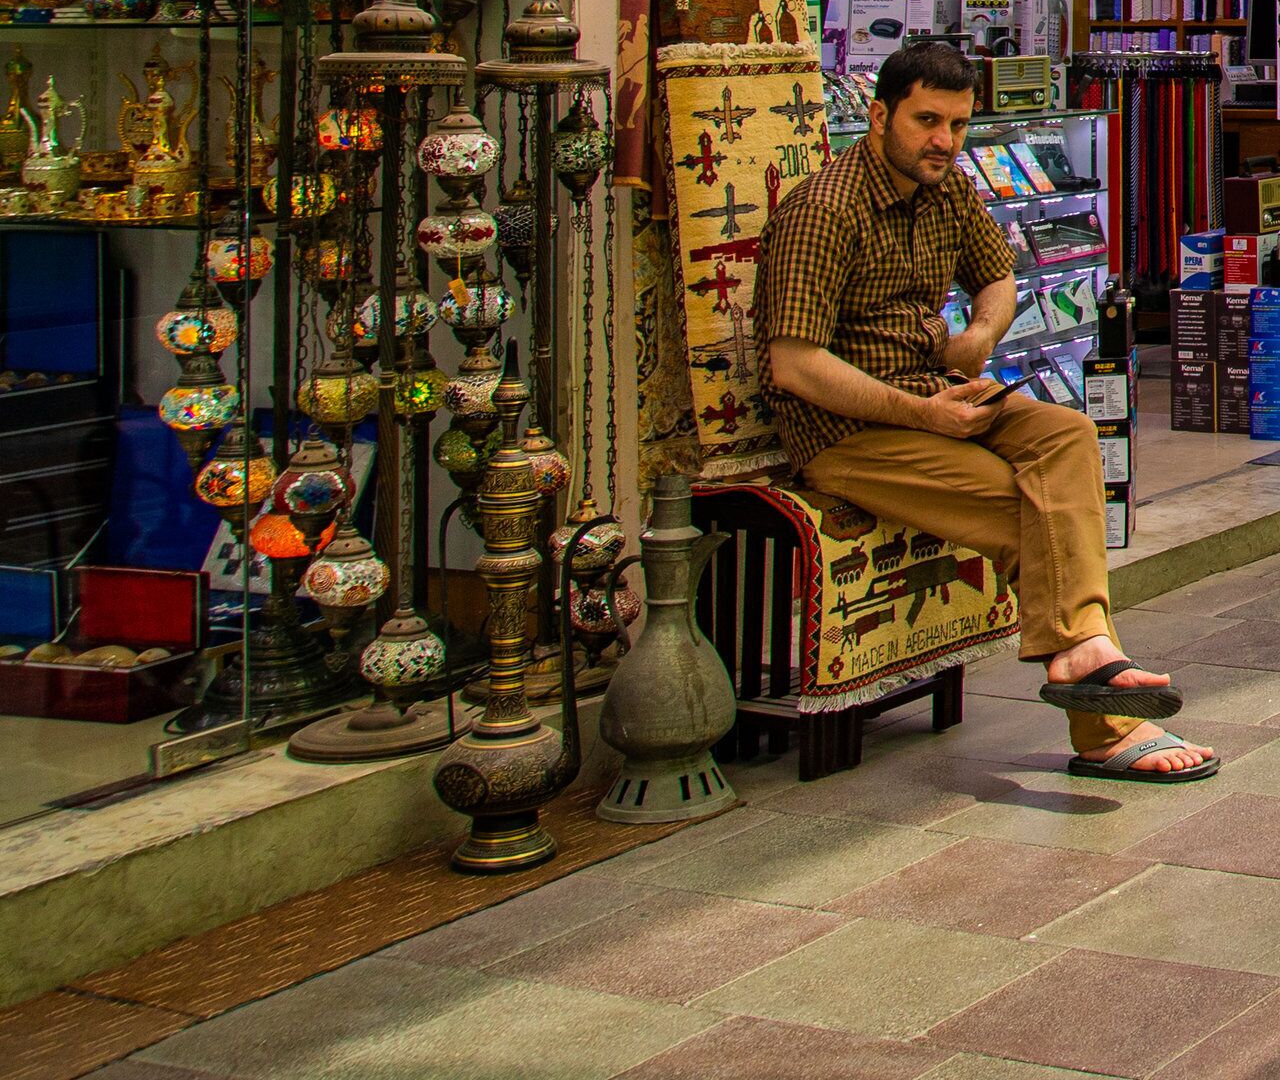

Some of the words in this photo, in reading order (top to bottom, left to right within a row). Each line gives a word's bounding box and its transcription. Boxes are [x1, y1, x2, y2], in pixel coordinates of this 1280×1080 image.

[848, 62, 873, 73] sanford
[776, 141, 811, 178] 2018
[851, 643, 885, 675] MADE
[887, 639, 899, 661] IN
[905, 613, 983, 655] AFGHANISTAN
